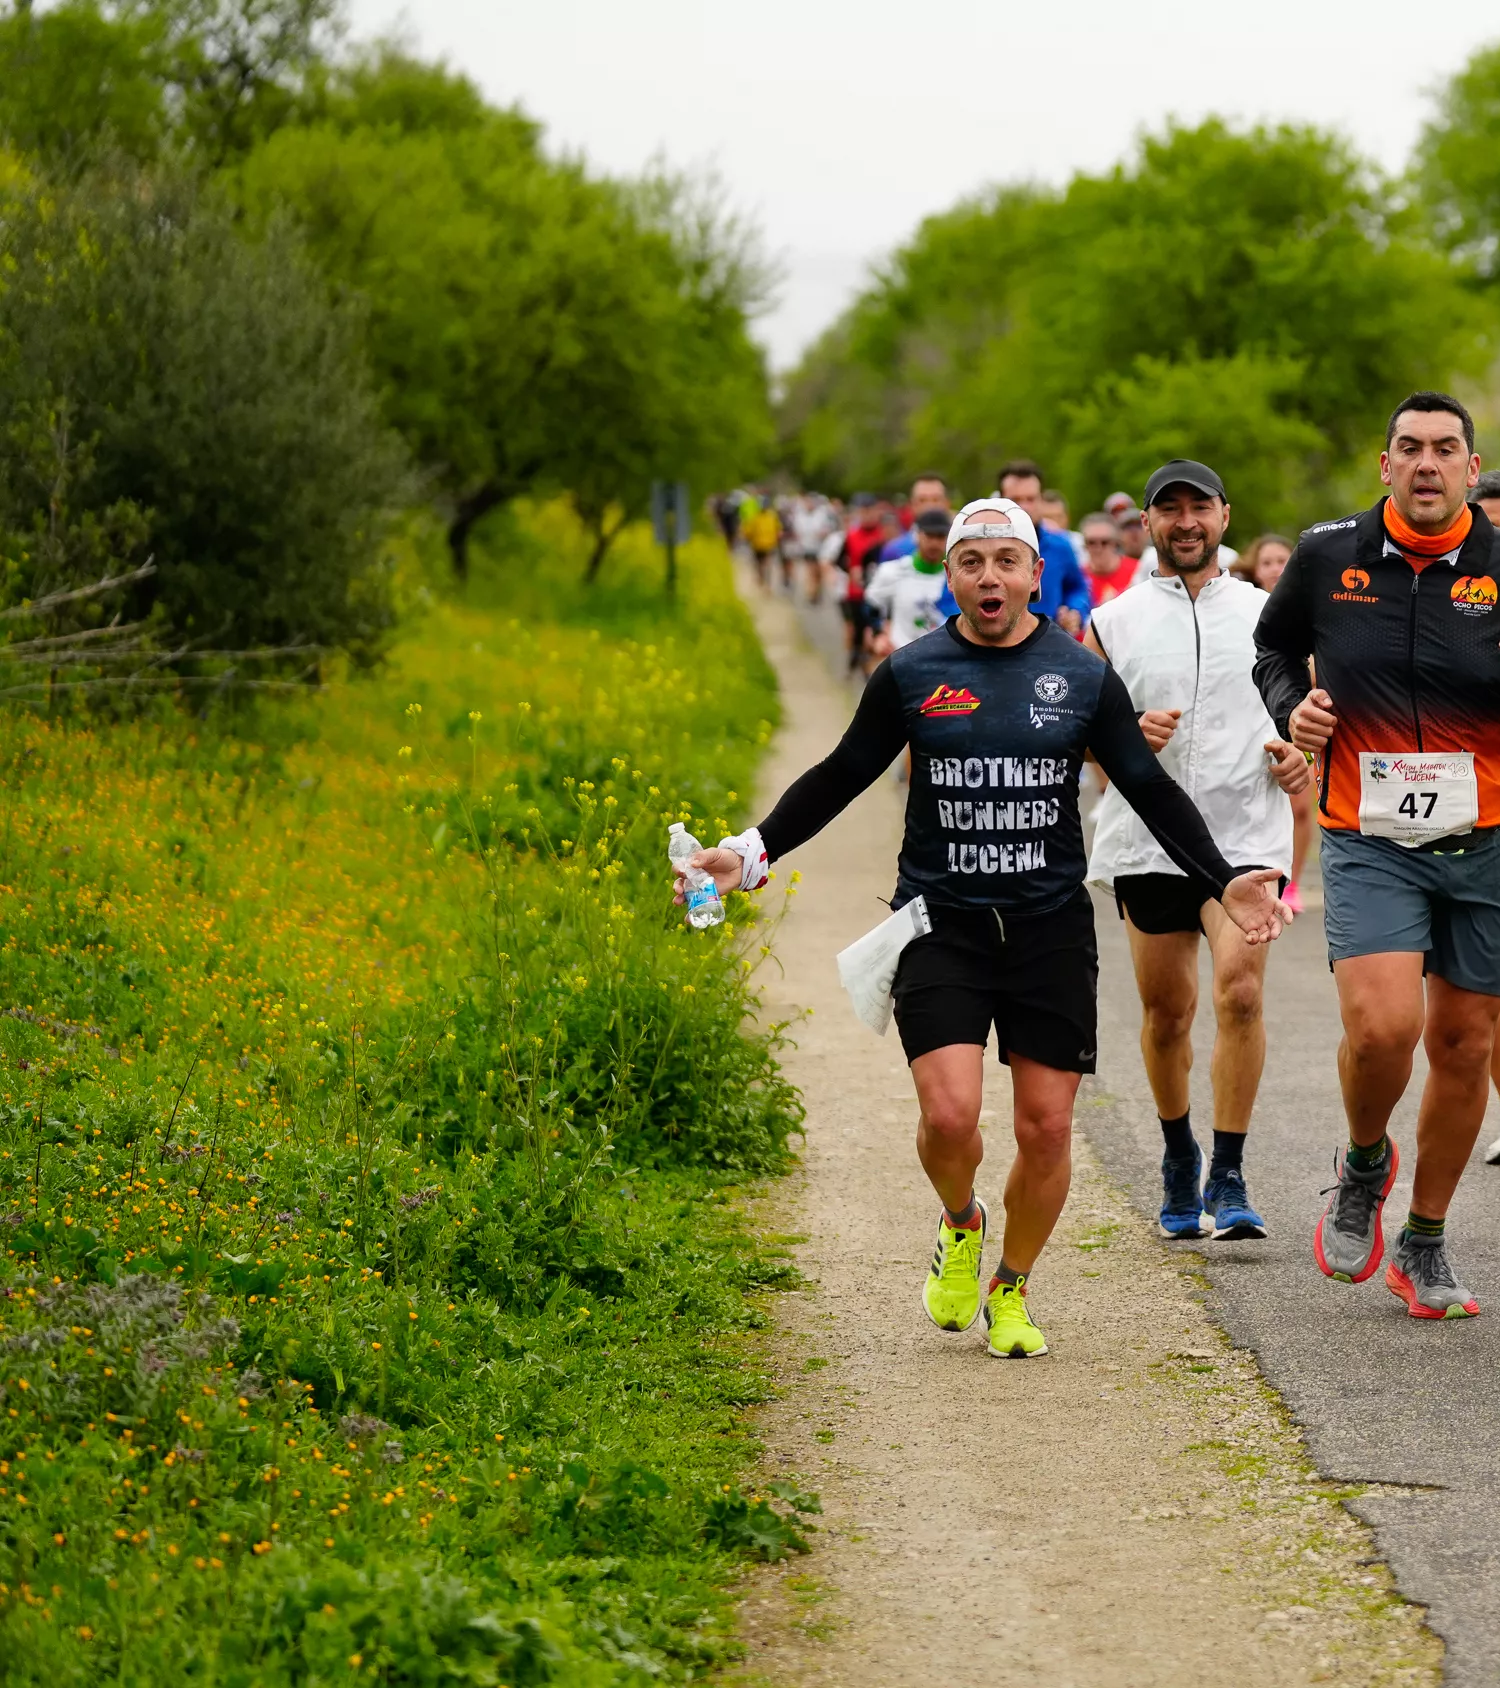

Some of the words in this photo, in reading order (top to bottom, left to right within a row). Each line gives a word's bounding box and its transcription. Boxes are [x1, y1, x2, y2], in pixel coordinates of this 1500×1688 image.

[930, 757, 1068, 788] BROTHERS
[1405, 772, 1440, 782] LUCENA
[938, 798, 1060, 830] RUNNERS
[1399, 792, 1438, 819] 47
[948, 840, 1047, 874] LUCENA
